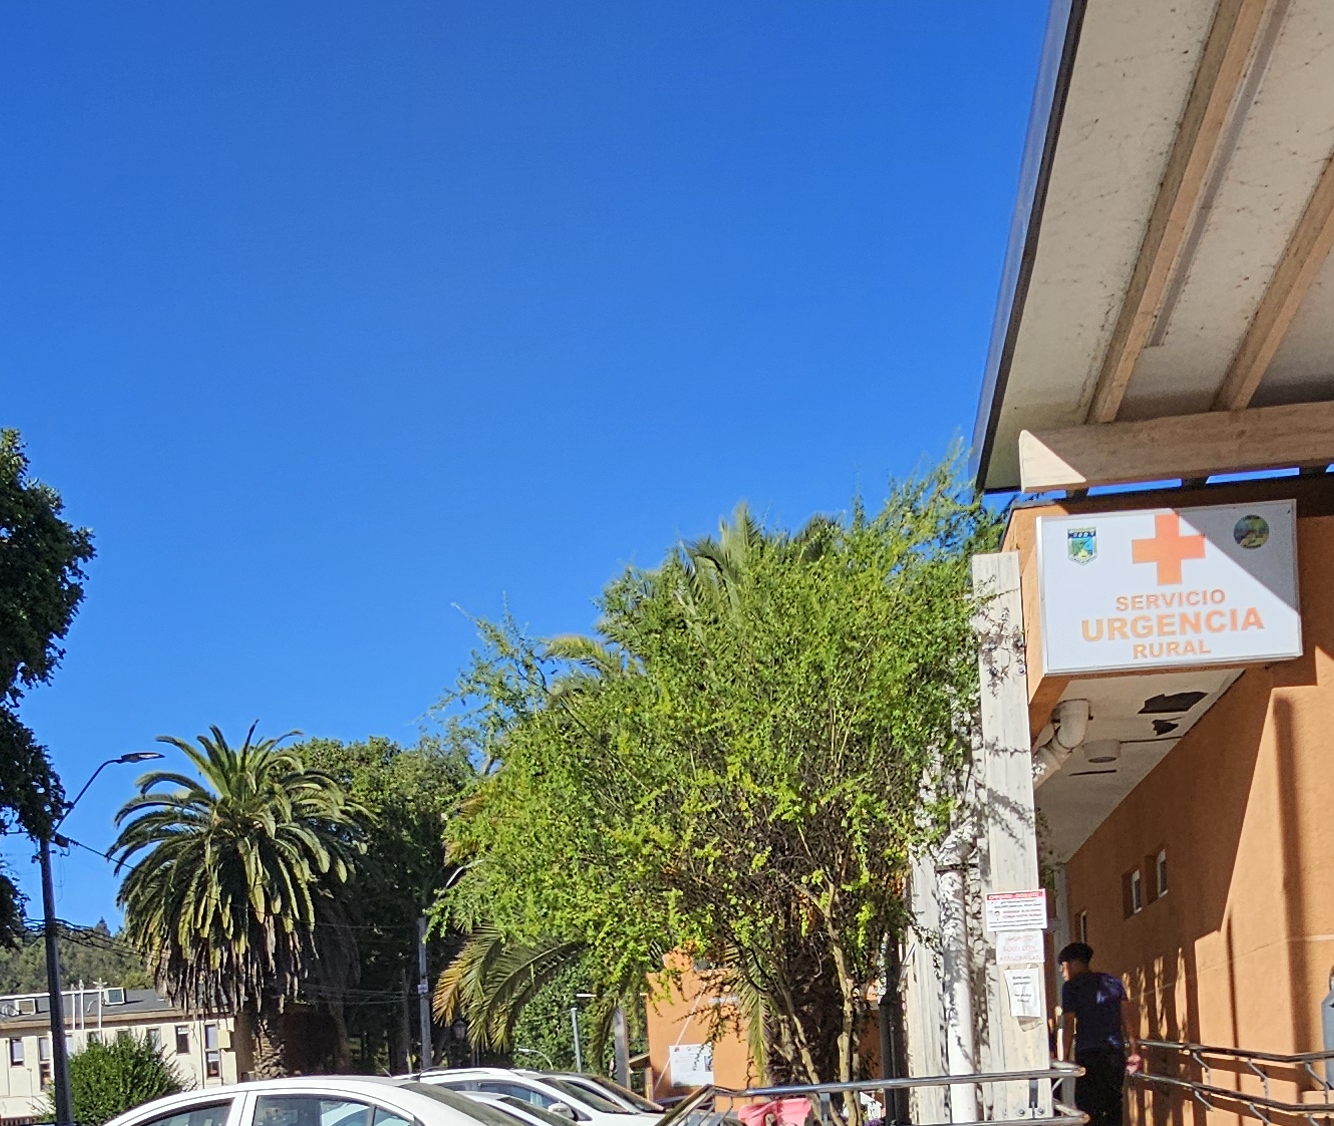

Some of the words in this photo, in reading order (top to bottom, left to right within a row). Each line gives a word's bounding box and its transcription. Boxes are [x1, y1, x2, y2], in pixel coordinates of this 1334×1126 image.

[1116, 589, 1226, 611] SERVICIO
[1081, 607, 1265, 642] URGENCIA
[1133, 639, 1211, 659] RURAL
